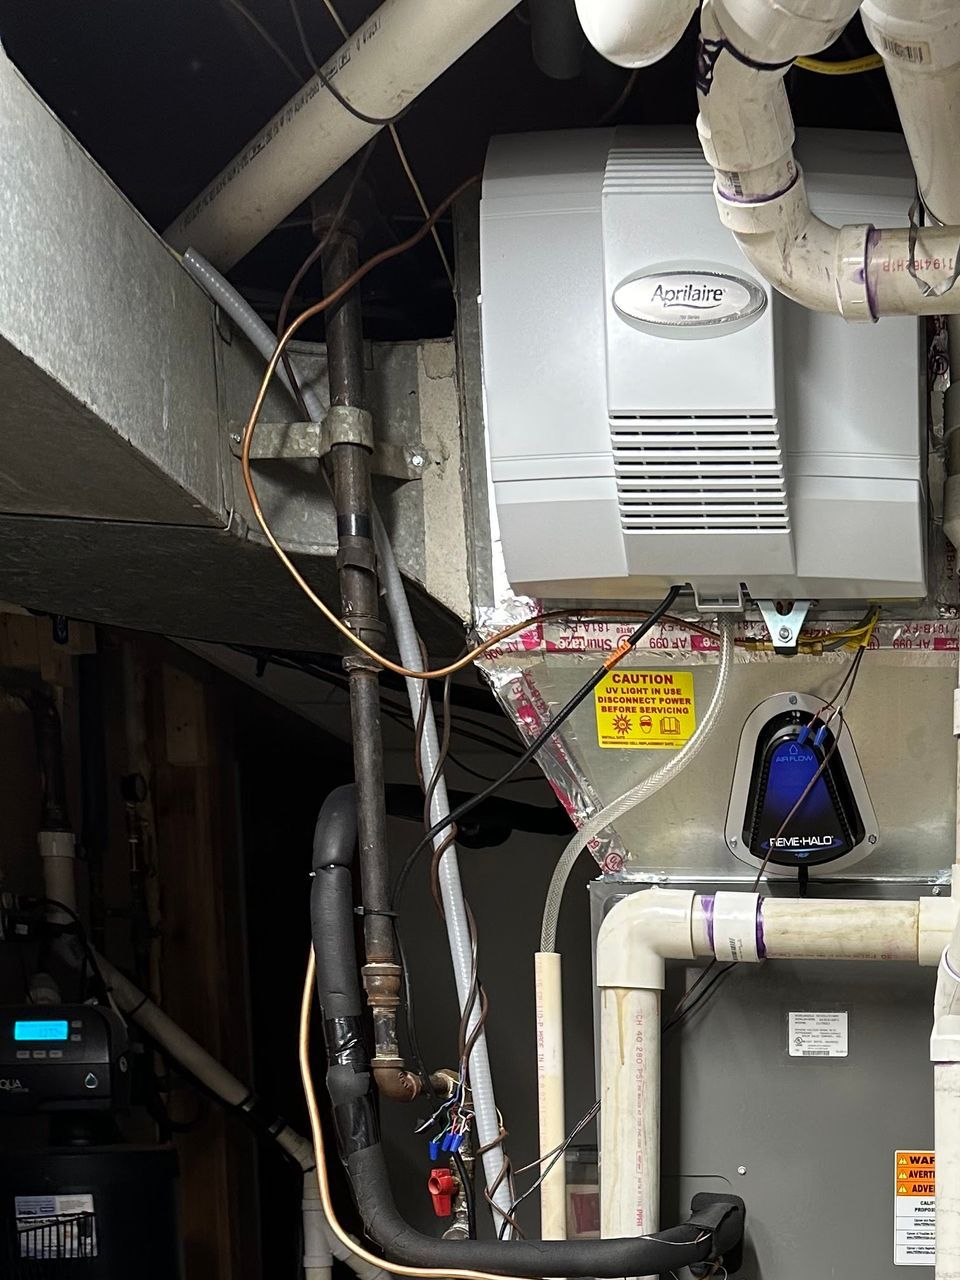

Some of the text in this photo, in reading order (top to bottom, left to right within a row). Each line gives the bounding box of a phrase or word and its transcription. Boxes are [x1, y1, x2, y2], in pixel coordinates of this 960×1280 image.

[651, 284, 724, 307] Aprilaire
[904, 624, 952, 634] 181B-FX
[649, 637, 670, 649] 099
[672, 637, 687, 649] AF
[892, 638, 913, 649] 099
[612, 674, 673, 684] CAUTION
[635, 1031, 643, 1043] 40
[635, 1047, 643, 1064] 280
